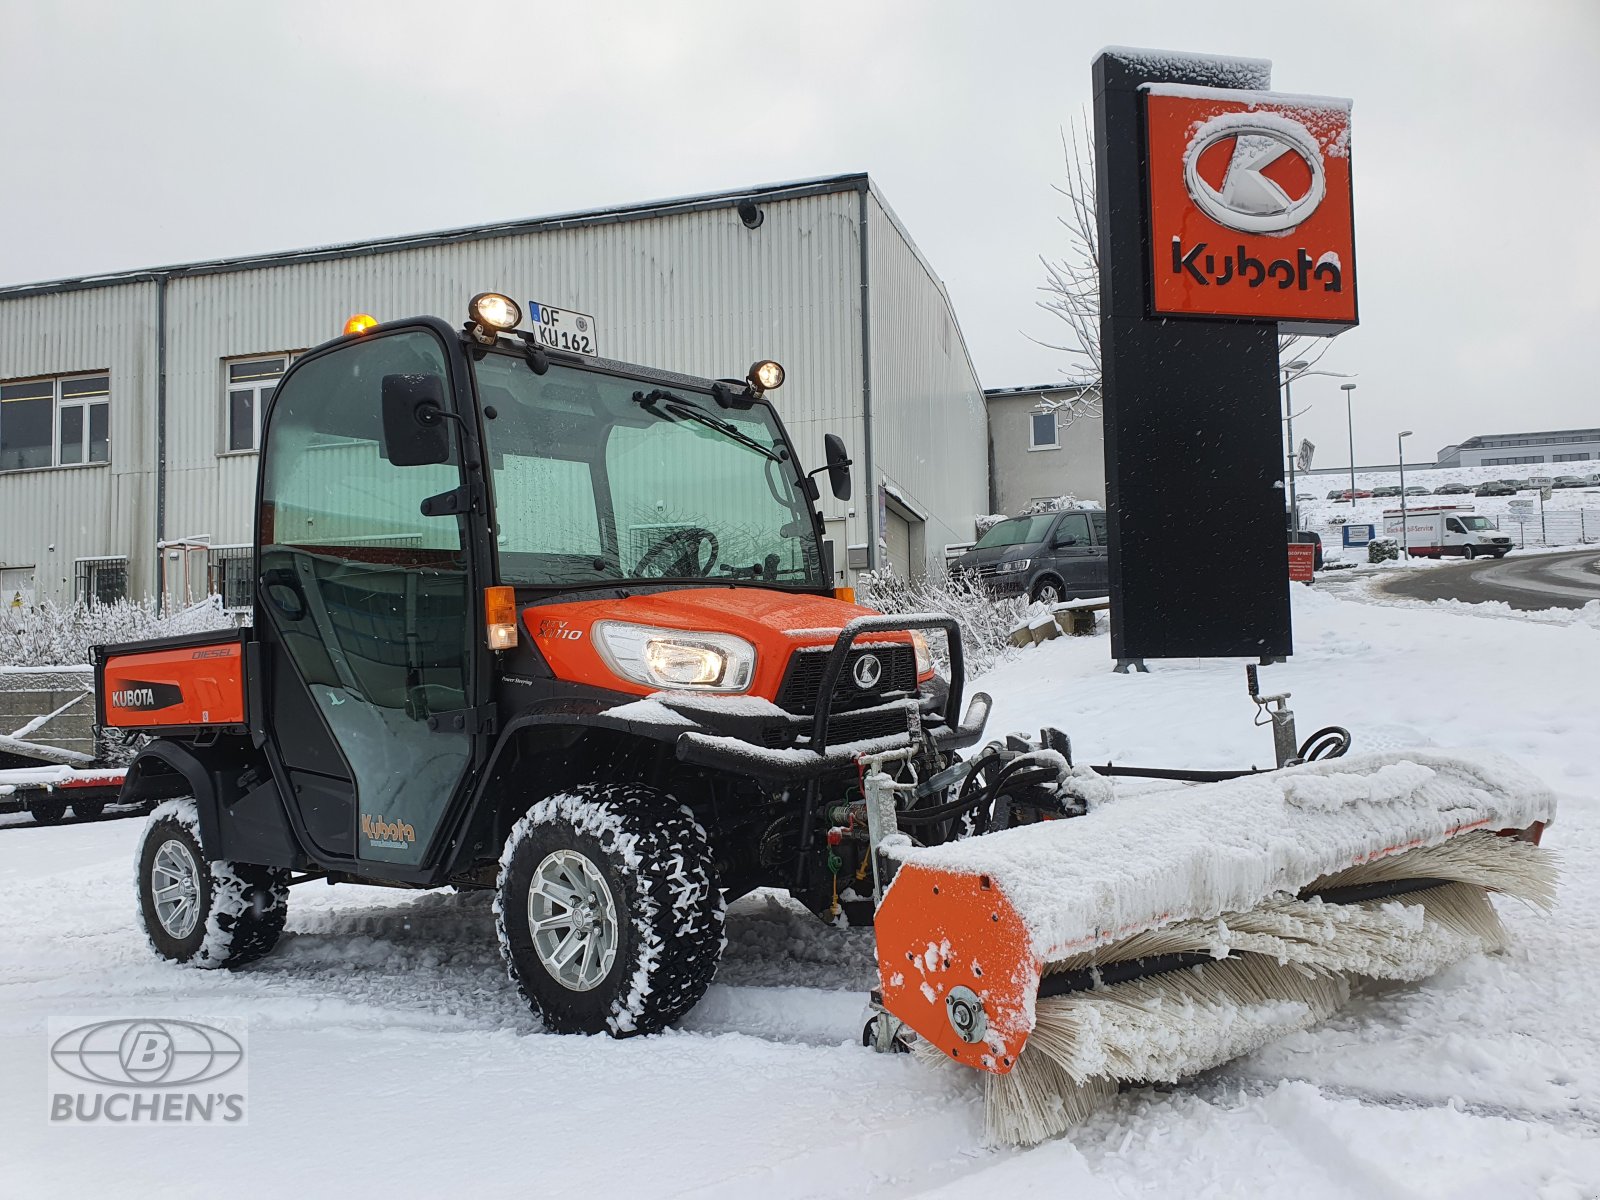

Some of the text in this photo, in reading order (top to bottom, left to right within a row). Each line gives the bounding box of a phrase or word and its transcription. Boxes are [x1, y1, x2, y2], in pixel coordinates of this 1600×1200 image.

[1172, 238, 1342, 293] Kubota
[541, 307, 560, 327] OF
[539, 325, 591, 354] KU 162
[540, 619, 569, 628] RTV
[191, 648, 233, 660] DIESEL
[515, 677, 533, 687] Steering
[112, 688, 155, 708] KUBOTA
[361, 813, 416, 842] Kubota
